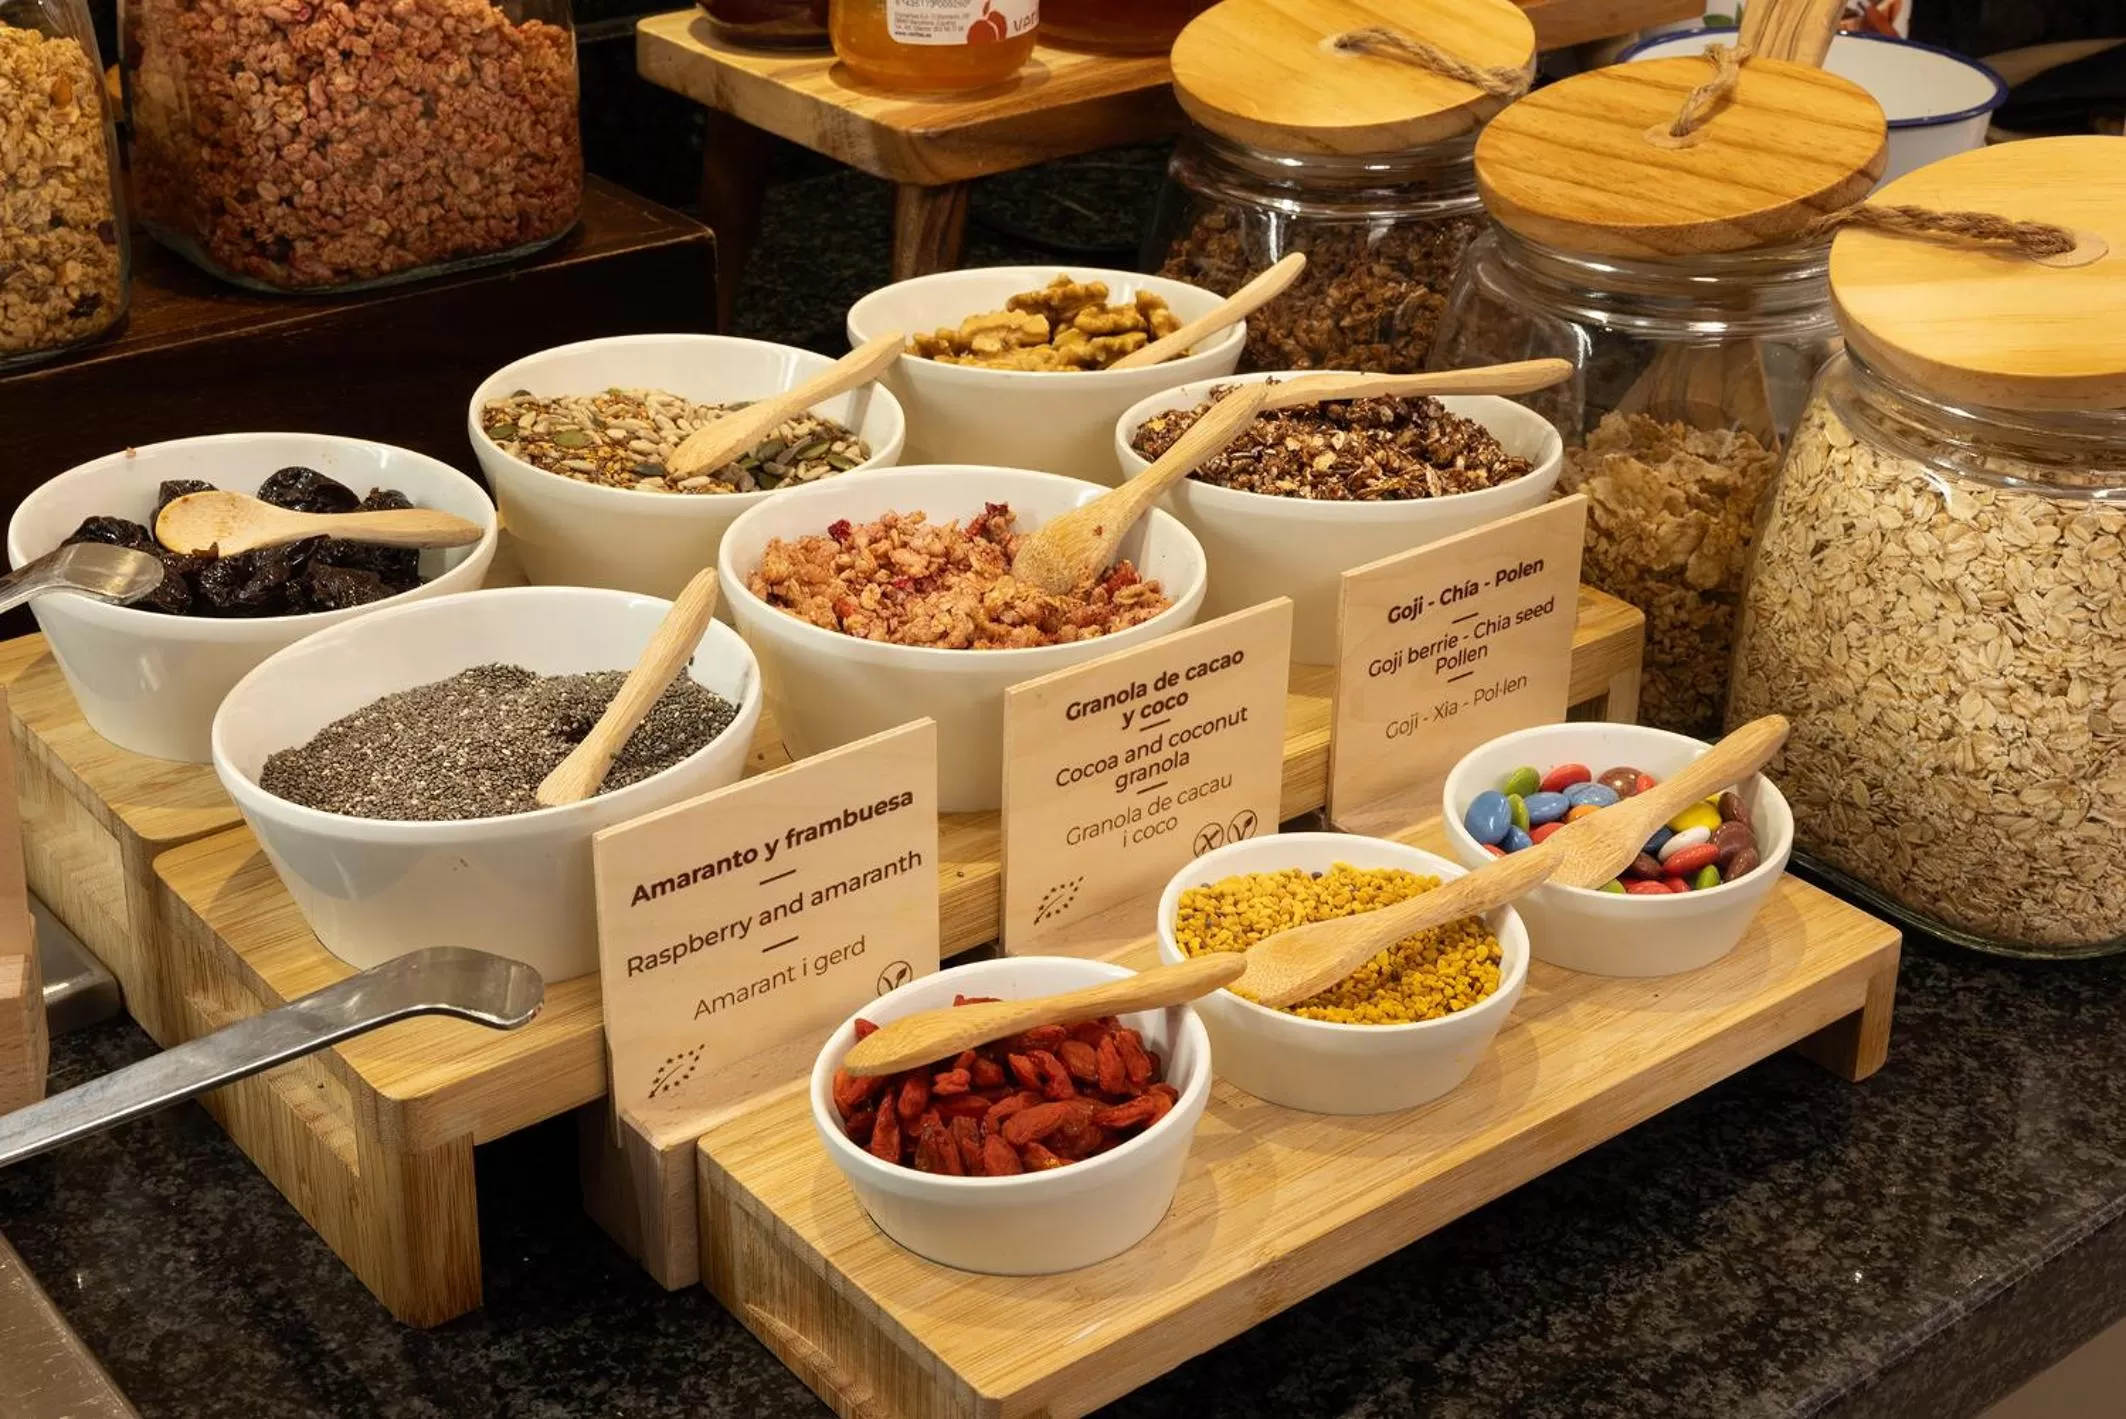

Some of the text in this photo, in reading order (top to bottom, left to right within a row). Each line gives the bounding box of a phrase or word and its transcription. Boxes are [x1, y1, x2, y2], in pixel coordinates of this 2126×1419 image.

[1387, 594, 1424, 624] Goji
[1439, 579, 1479, 607] Chía
[1495, 557, 1545, 588] Polen
[1368, 650, 1403, 678] Goji
[1407, 633, 1459, 664] berrie
[1473, 615, 1511, 640] Chia
[1515, 596, 1555, 625] seed
[1434, 643, 1488, 675] Pollen
[1065, 648, 1245, 722] Granola de cacao
[1121, 689, 1189, 730] y coco
[1385, 712, 1418, 739] Goji
[1432, 700, 1458, 723] Xia
[1055, 705, 1249, 788] Cocoa and coconut
[1114, 749, 1191, 794] granola
[1065, 772, 1233, 847] Granola de cacau
[1122, 815, 1178, 848] i coco
[630, 789, 914, 907] Amaranto y frambuesa
[626, 850, 923, 978] Raspberry and amaranth
[692, 935, 867, 1020] Amarant i gerd
